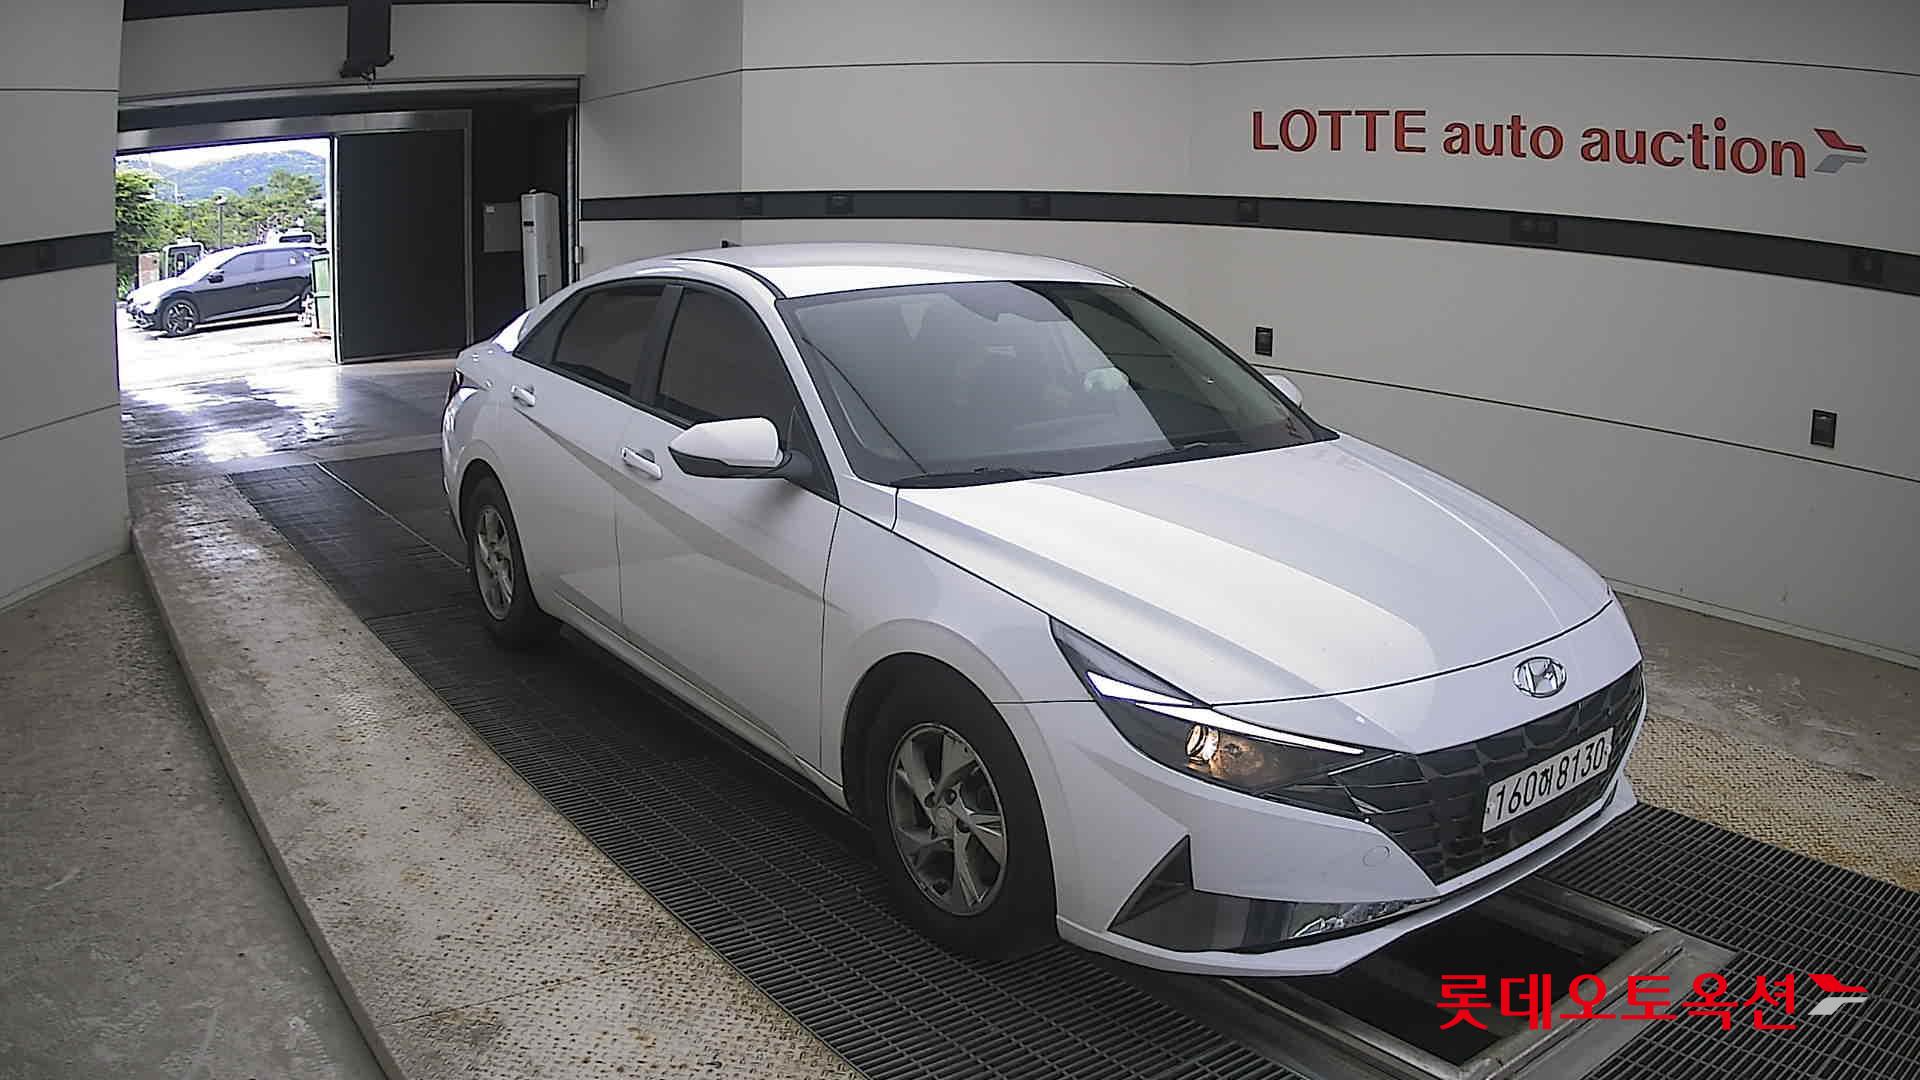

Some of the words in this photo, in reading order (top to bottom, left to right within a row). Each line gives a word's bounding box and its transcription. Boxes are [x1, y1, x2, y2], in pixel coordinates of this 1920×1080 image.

[1252, 109, 1427, 154] LOTTE
[1442, 114, 1564, 161] auto
[1579, 116, 1807, 180] auction
[1556, 736, 1606, 791] 8130
